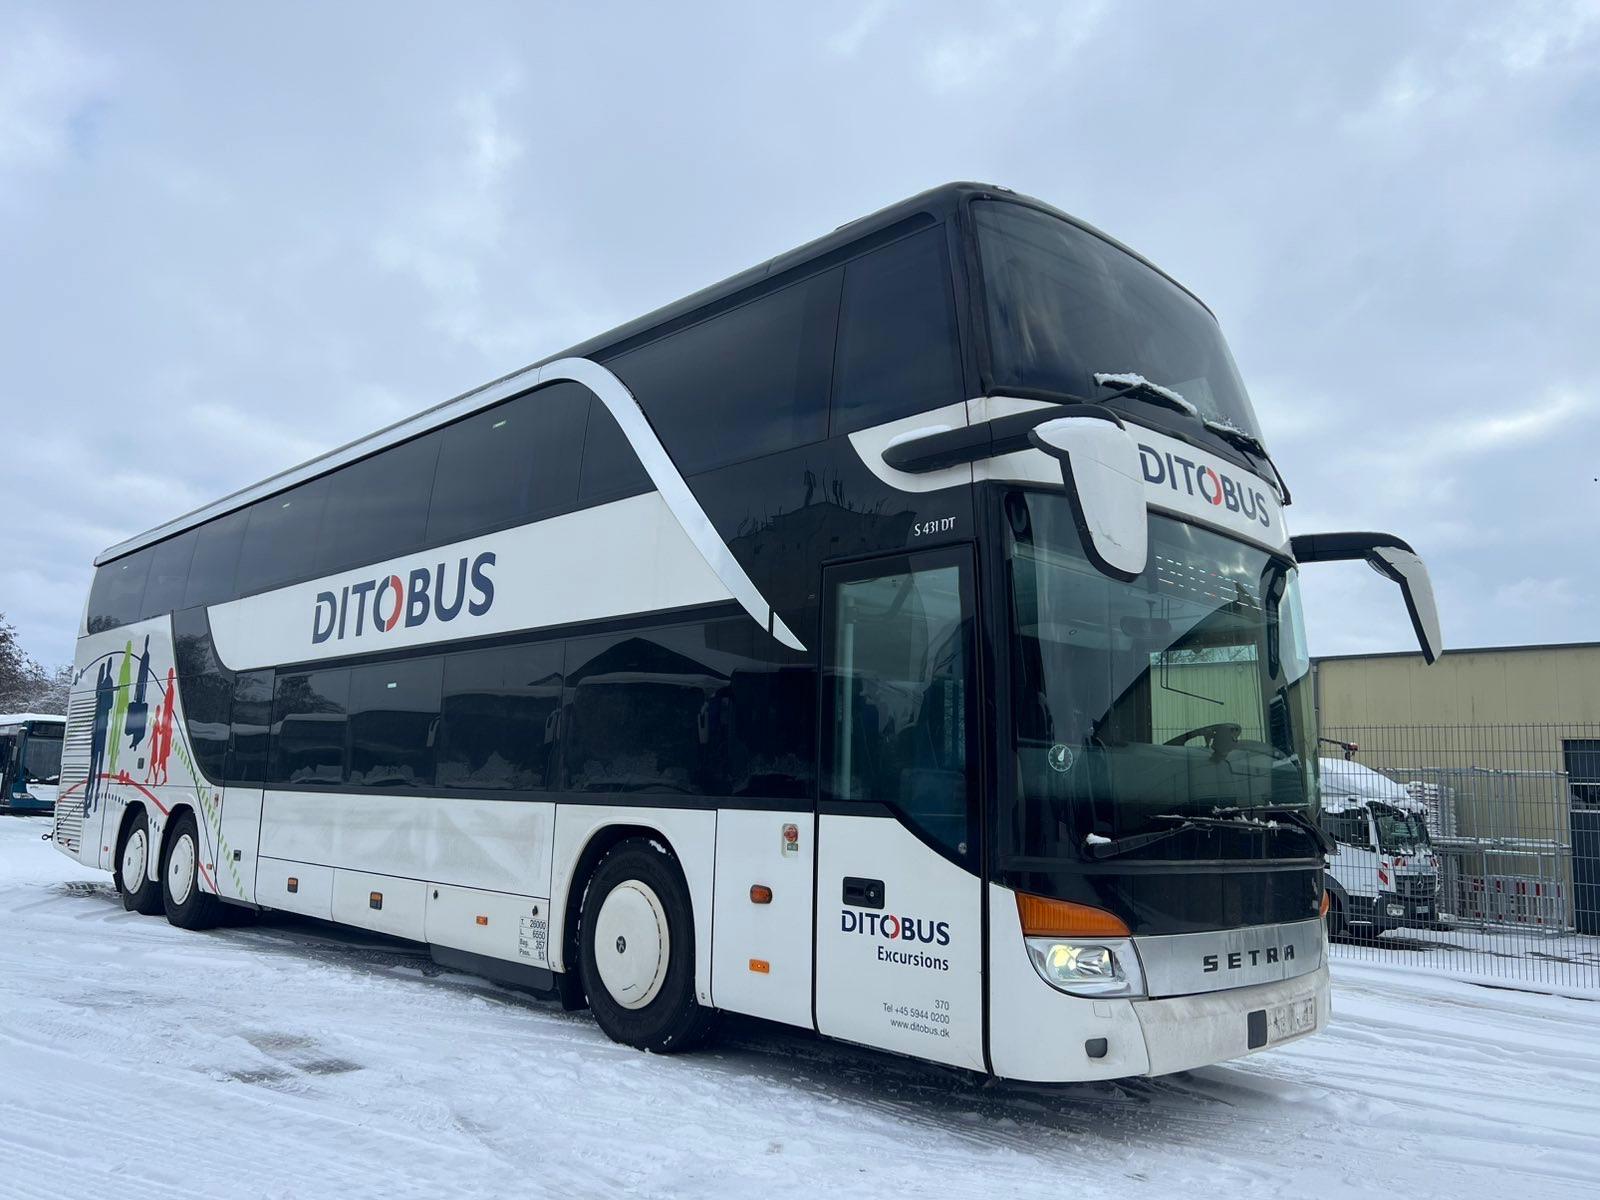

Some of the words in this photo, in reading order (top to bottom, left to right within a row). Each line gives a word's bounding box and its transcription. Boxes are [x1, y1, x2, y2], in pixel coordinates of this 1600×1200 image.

[1138, 443, 1270, 527] DITOBUS
[914, 523, 920, 536] S
[923, 520, 939, 535] 431
[941, 516, 956, 531] DT
[312, 552, 496, 644] DITOBUS
[530, 919, 546, 930] 26000
[841, 910, 950, 946] DITOBUS
[877, 945, 949, 971] Excursions
[1203, 944, 1295, 973] SETRA
[882, 1002, 893, 1013] Tel
[895, 1006, 909, 1017] +45
[910, 1008, 929, 1020] 5944
[930, 1012, 950, 1025] 0200
[934, 999, 950, 1011] 370
[890, 1019, 951, 1039] www.ditobus.dk
